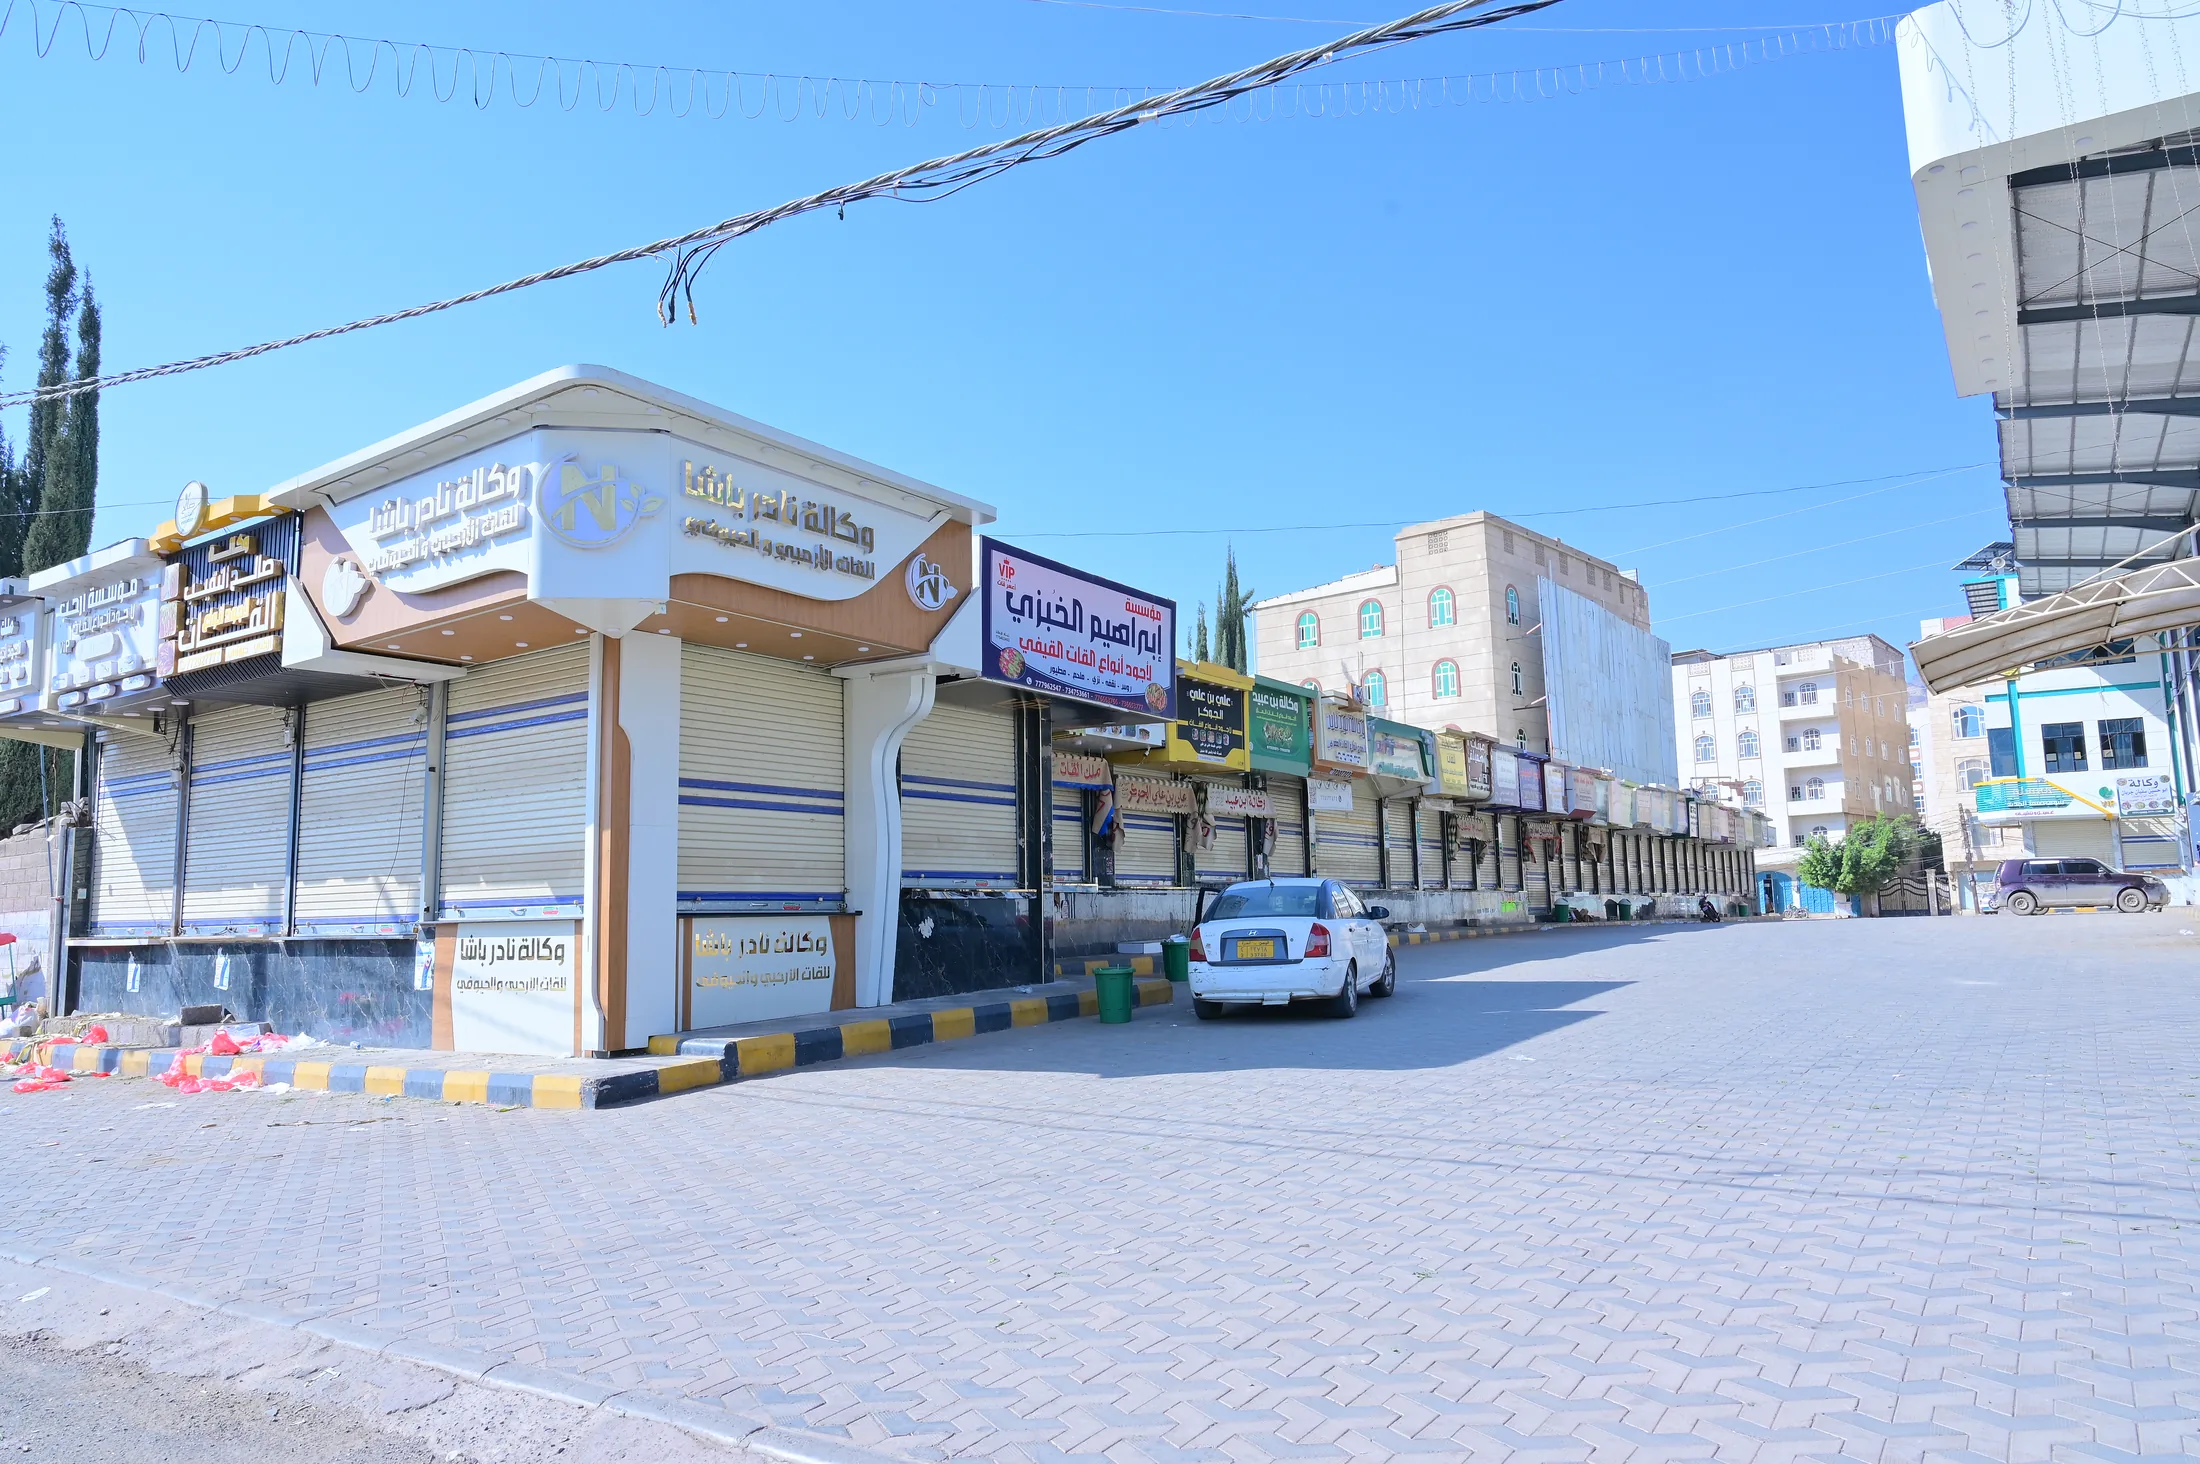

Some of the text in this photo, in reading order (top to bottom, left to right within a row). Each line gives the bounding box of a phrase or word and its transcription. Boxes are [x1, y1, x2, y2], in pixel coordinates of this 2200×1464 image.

[369, 462, 522, 539] وكالة نادر باشا
[682, 459, 875, 554] وكالة نادر باشا
[998, 562, 1016, 579] VIP
[1125, 597, 1162, 622] مؤسسة
[1019, 636, 1064, 660] القيفي
[1090, 614, 1162, 662] إبراهيم
[1066, 644, 1096, 668] القات
[1098, 653, 1124, 676] أنواع
[1125, 660, 1152, 682] لأجود
[1197, 706, 1224, 720] الجوكر
[1279, 695, 1299, 714] وكالة
[2128, 778, 2159, 789] وكالة
[460, 934, 565, 967] وكالة نادر باشا
[695, 928, 828, 962] وكالة نادر باشا
[540, 976, 567, 992] للقات
[801, 965, 831, 981] للقات
